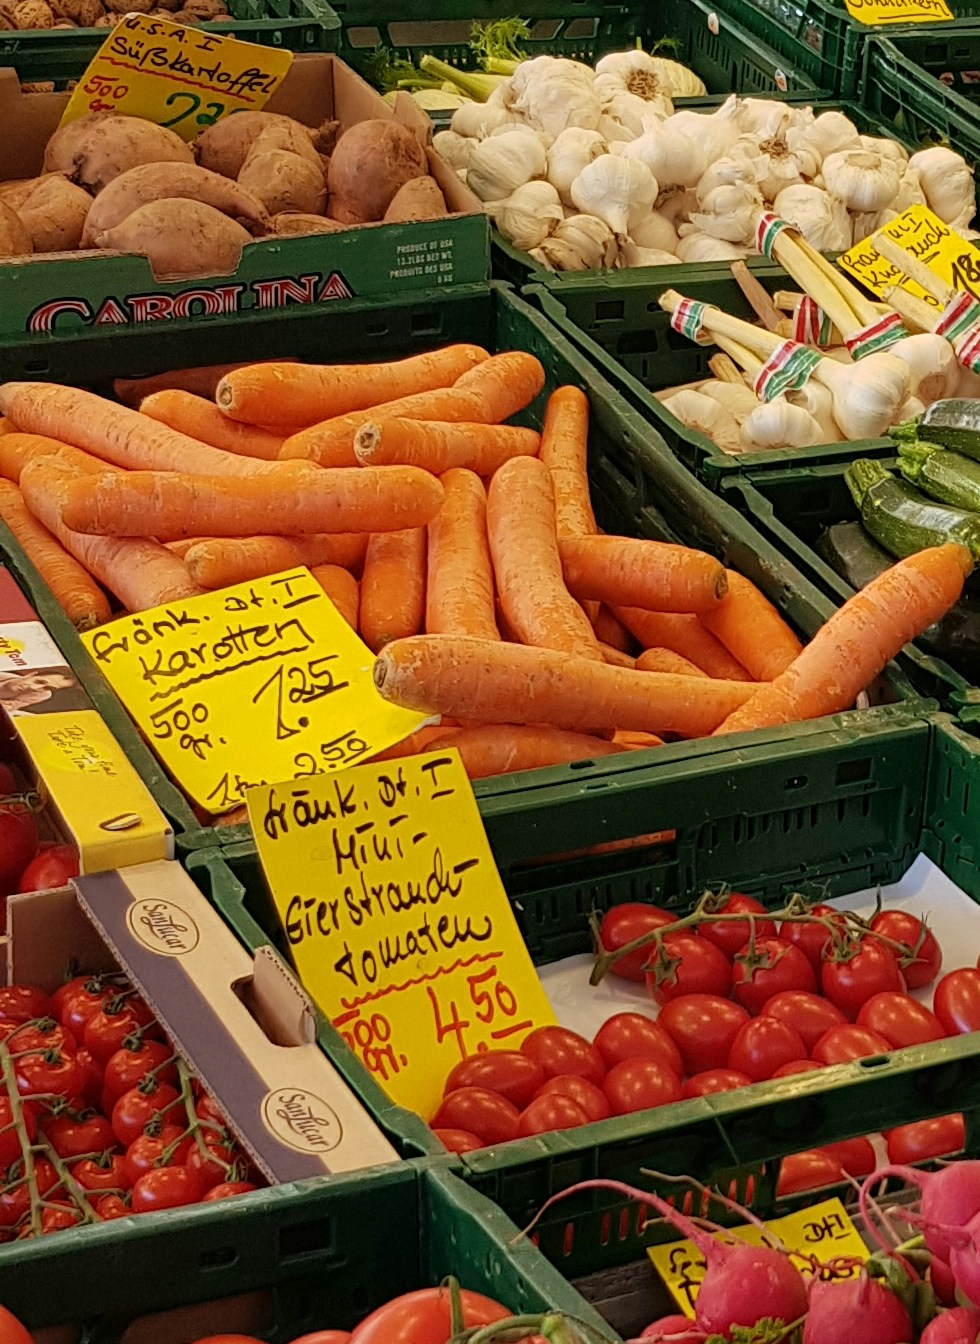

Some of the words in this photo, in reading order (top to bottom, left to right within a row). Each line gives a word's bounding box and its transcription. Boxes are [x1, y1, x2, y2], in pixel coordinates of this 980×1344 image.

[83, 74, 129, 100] 500
[110, 35, 278, 95] Süßkartoffel
[26, 272, 356, 333] CAROLINA
[138, 617, 316, 686] Karotten
[149, 697, 210, 739] 500
[179, 734, 227, 761] gr.
[139, 902, 188, 950] SanLucar
[276, 1093, 331, 1147] SanLucar
